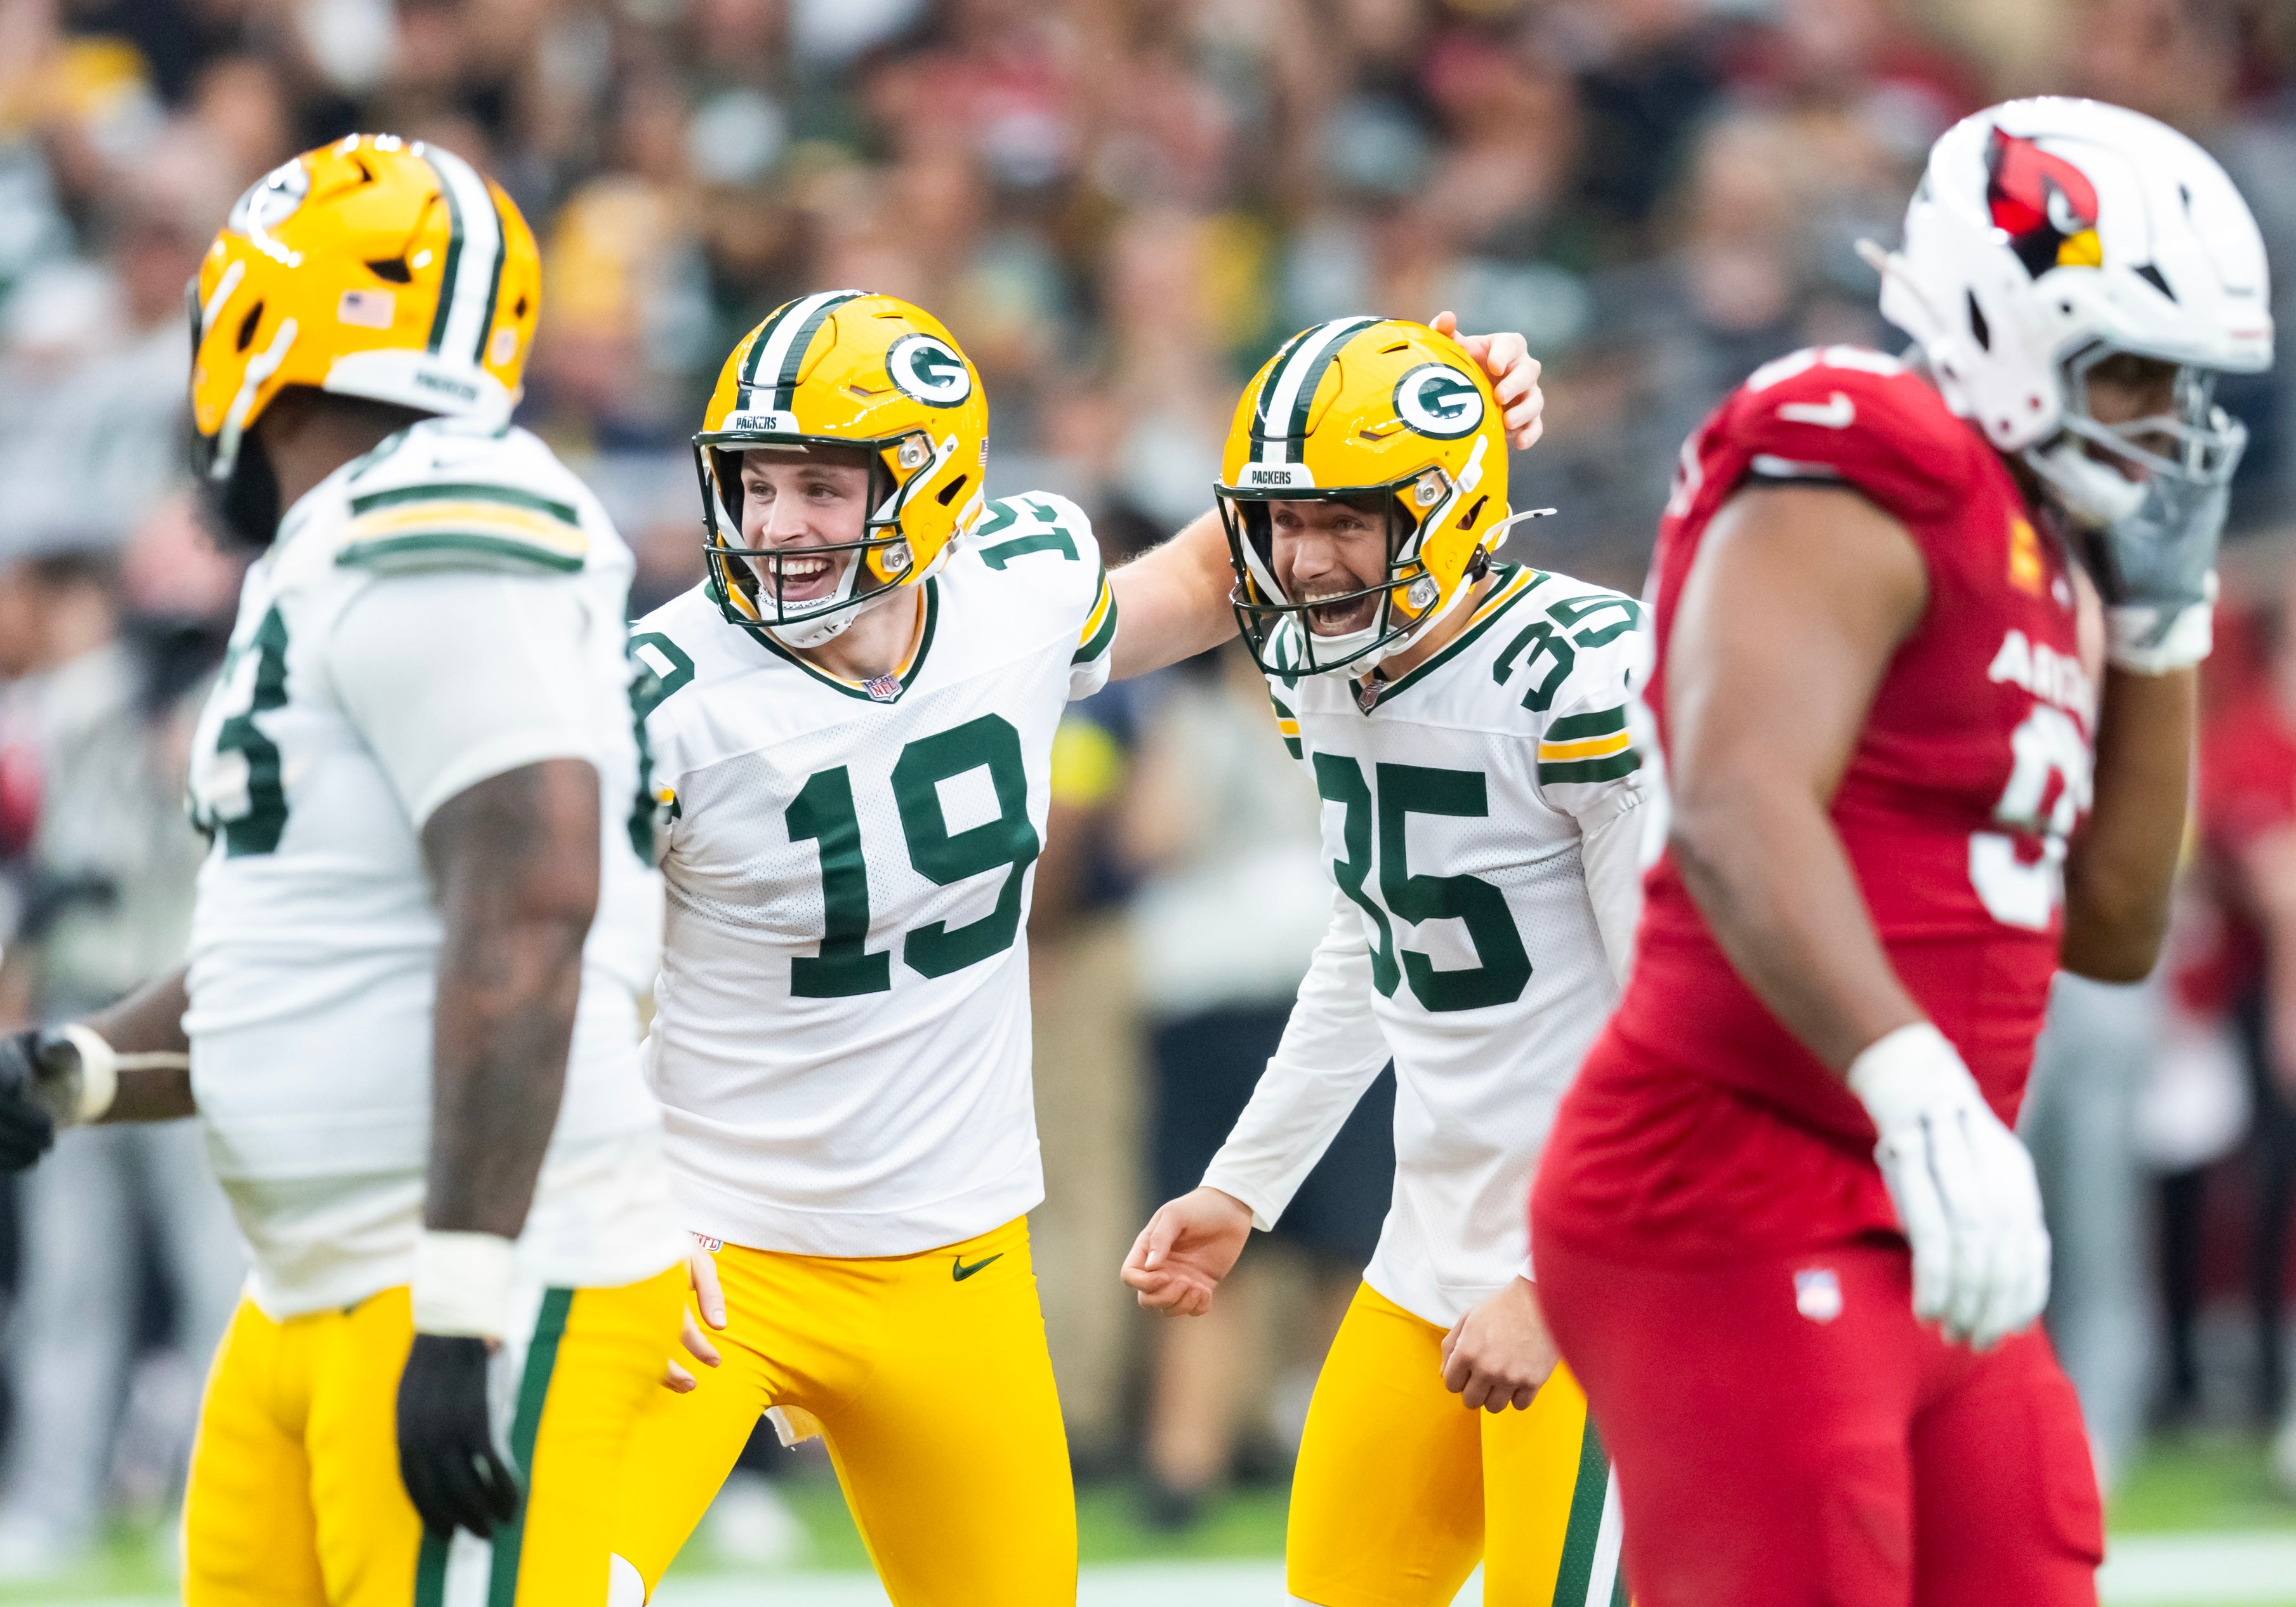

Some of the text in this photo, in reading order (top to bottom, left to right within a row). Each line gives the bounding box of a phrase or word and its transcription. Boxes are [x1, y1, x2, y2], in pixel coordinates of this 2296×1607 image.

[736, 416, 777, 430] PACKERS
[1252, 470, 1291, 485] PACKERS
[1493, 594, 1645, 713] 35
[871, 680, 897, 696] NFL
[785, 712, 1040, 998] 19
[1312, 751, 1533, 1013] 35
